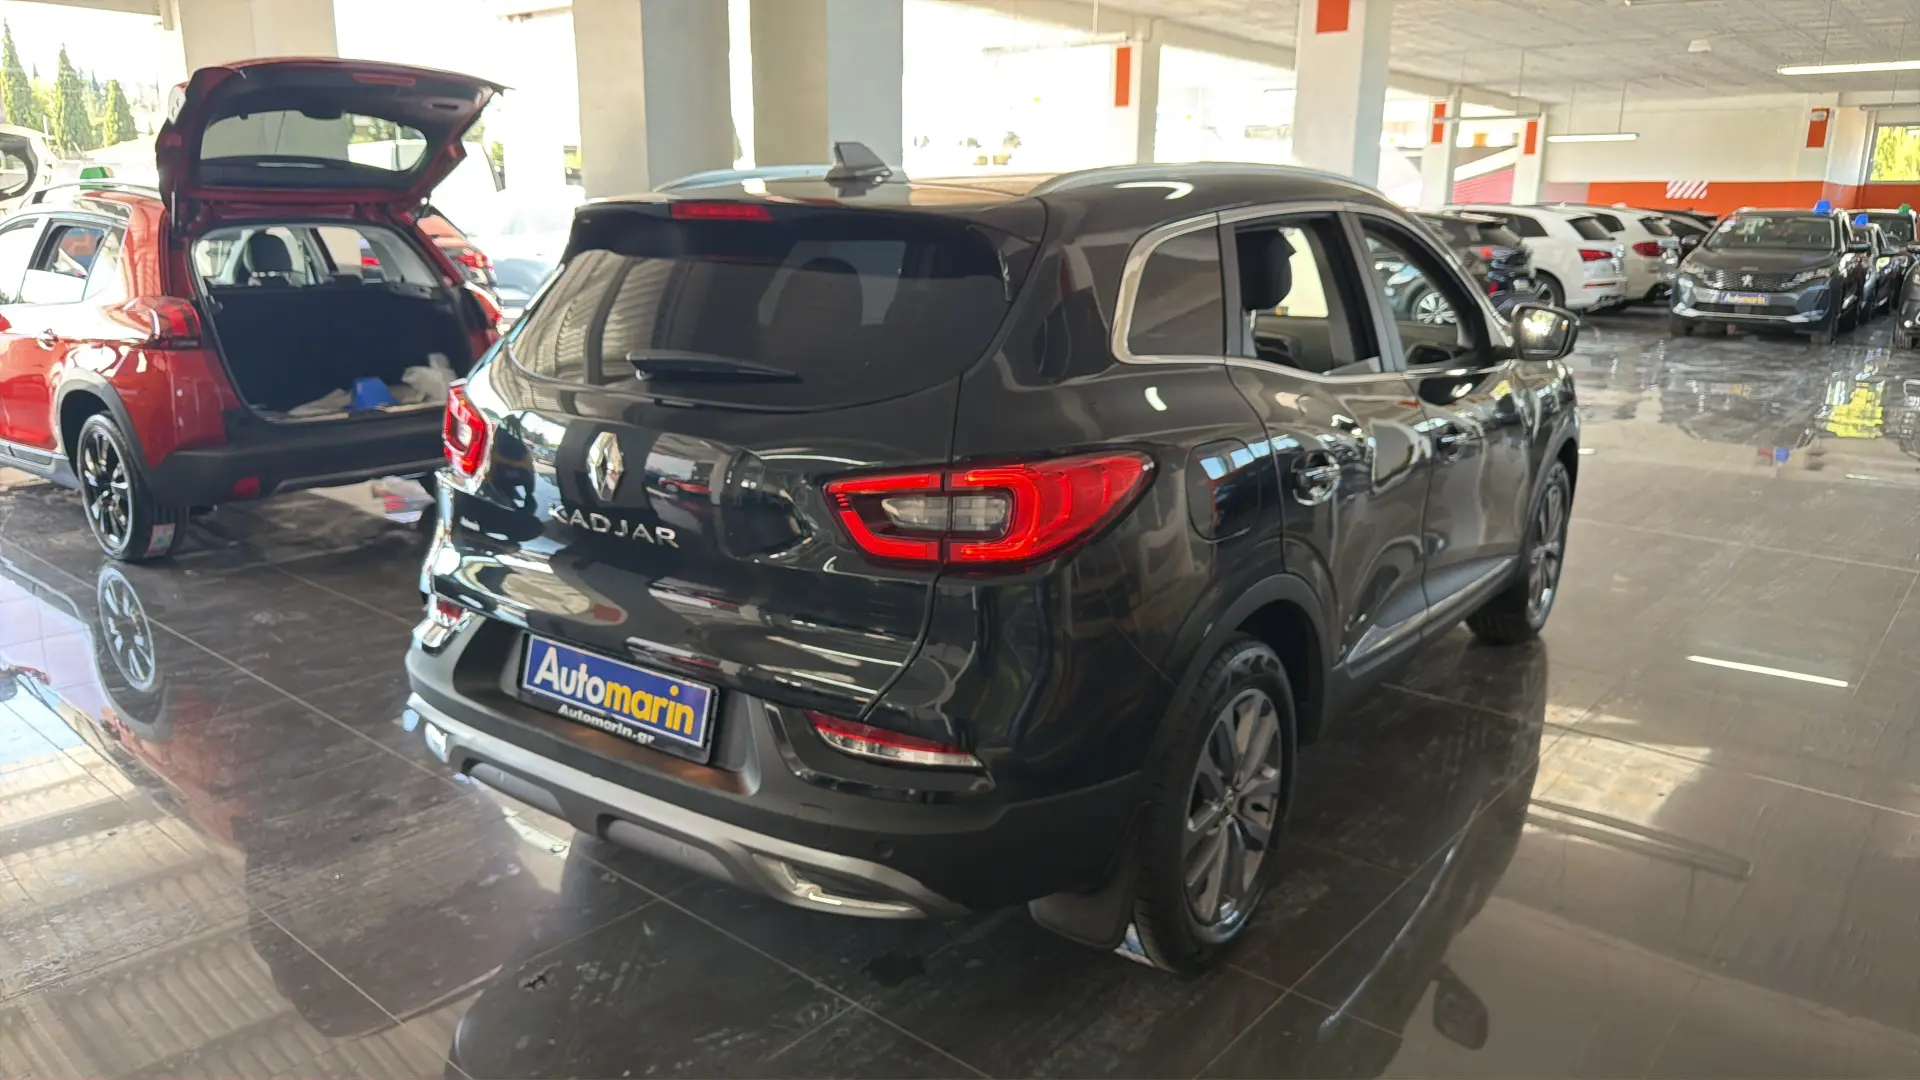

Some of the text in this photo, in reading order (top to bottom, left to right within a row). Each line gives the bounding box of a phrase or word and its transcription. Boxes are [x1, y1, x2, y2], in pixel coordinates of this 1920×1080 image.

[547, 503, 680, 549] KADJAR
[533, 646, 696, 736] Automarin
[557, 703, 656, 746] Automarin.gr
